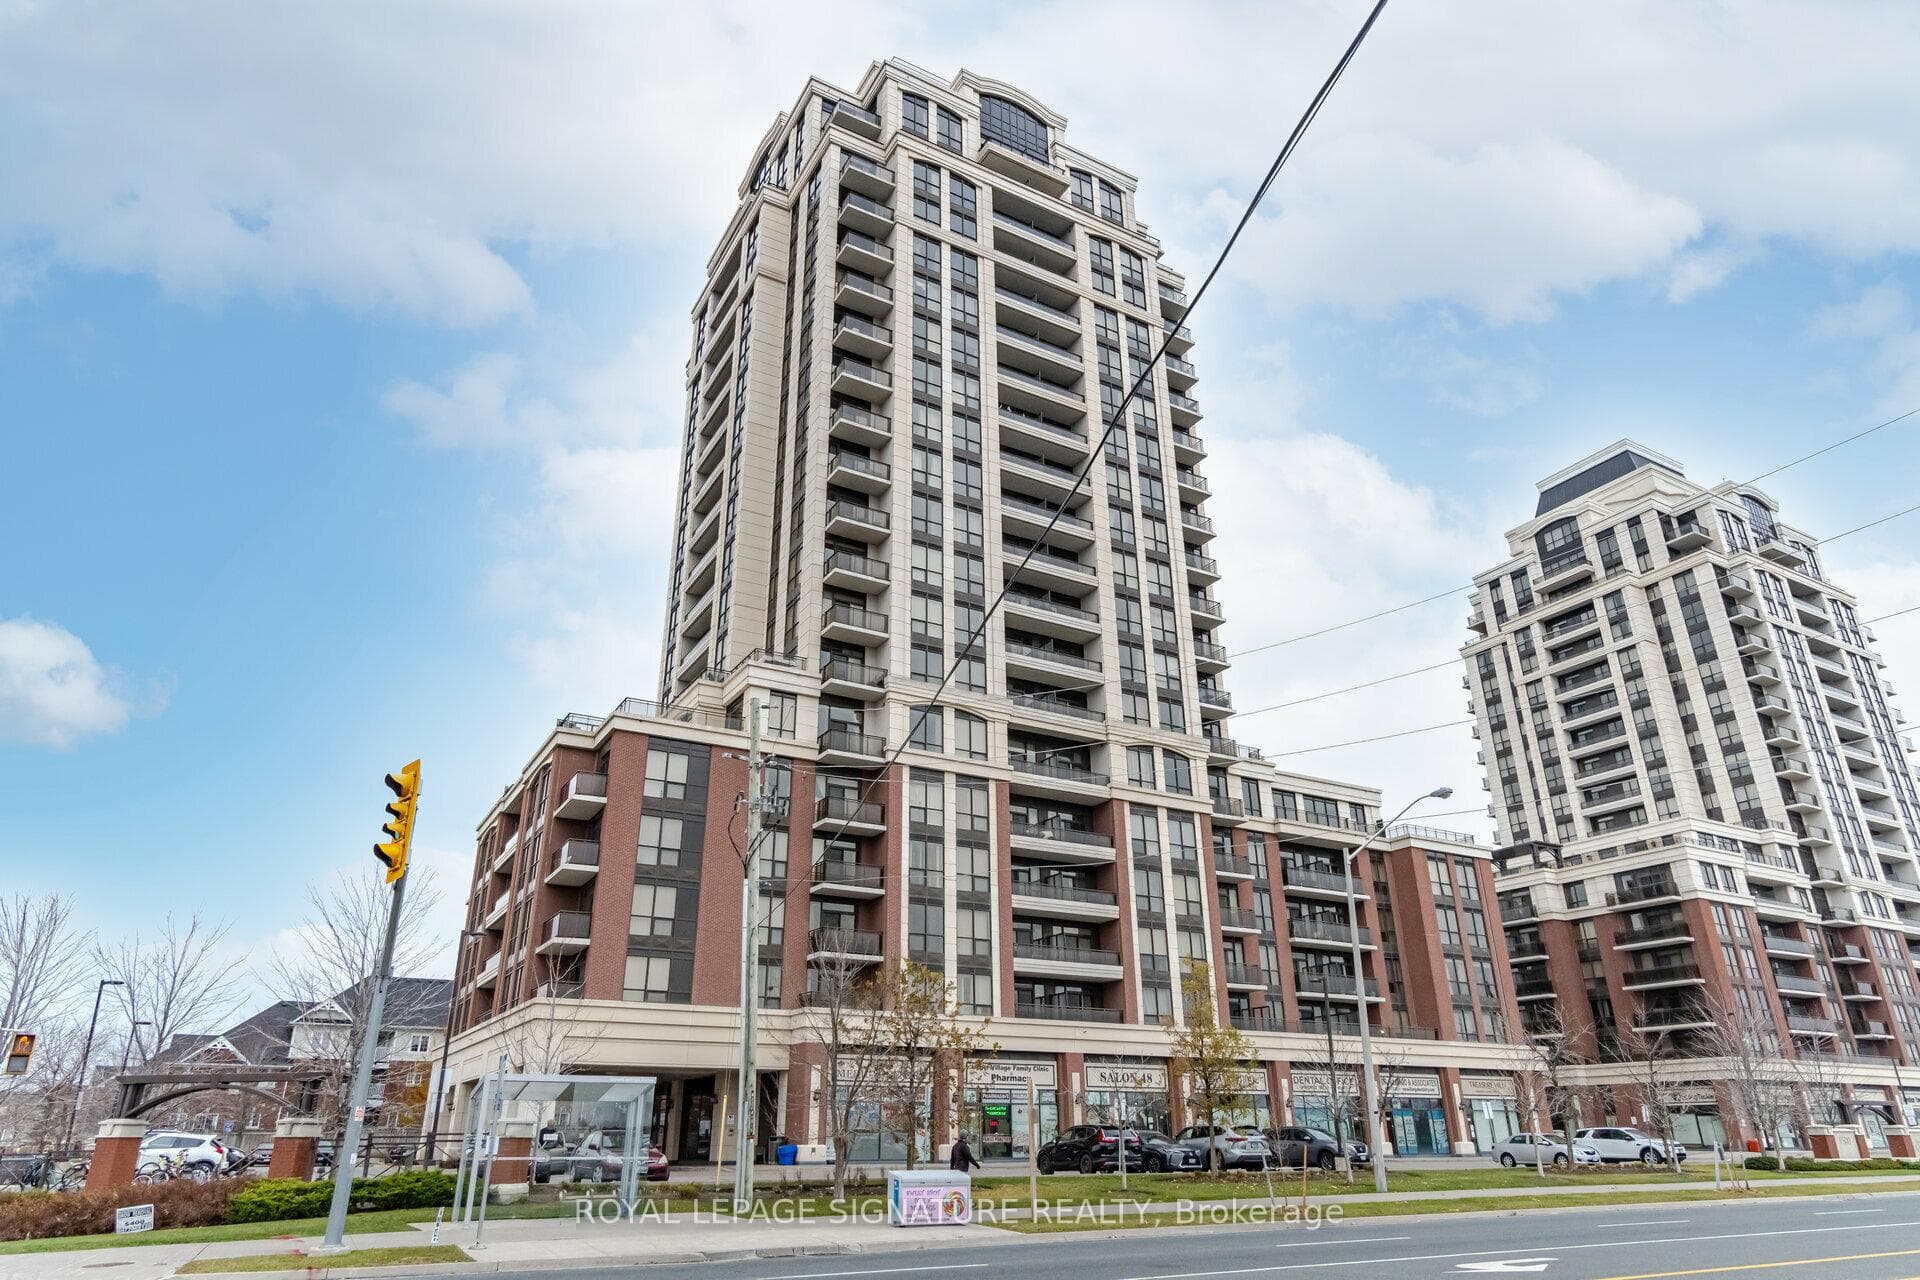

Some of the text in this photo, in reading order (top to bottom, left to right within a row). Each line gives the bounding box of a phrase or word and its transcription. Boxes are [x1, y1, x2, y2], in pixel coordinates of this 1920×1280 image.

[991, 1064, 1011, 1072] Village
[1012, 1065, 1032, 1073] Family
[1033, 1064, 1049, 1072] Clinic
[1100, 1071, 1153, 1084] SALON 48
[1293, 1075, 1355, 1086] DENTAL OFICE
